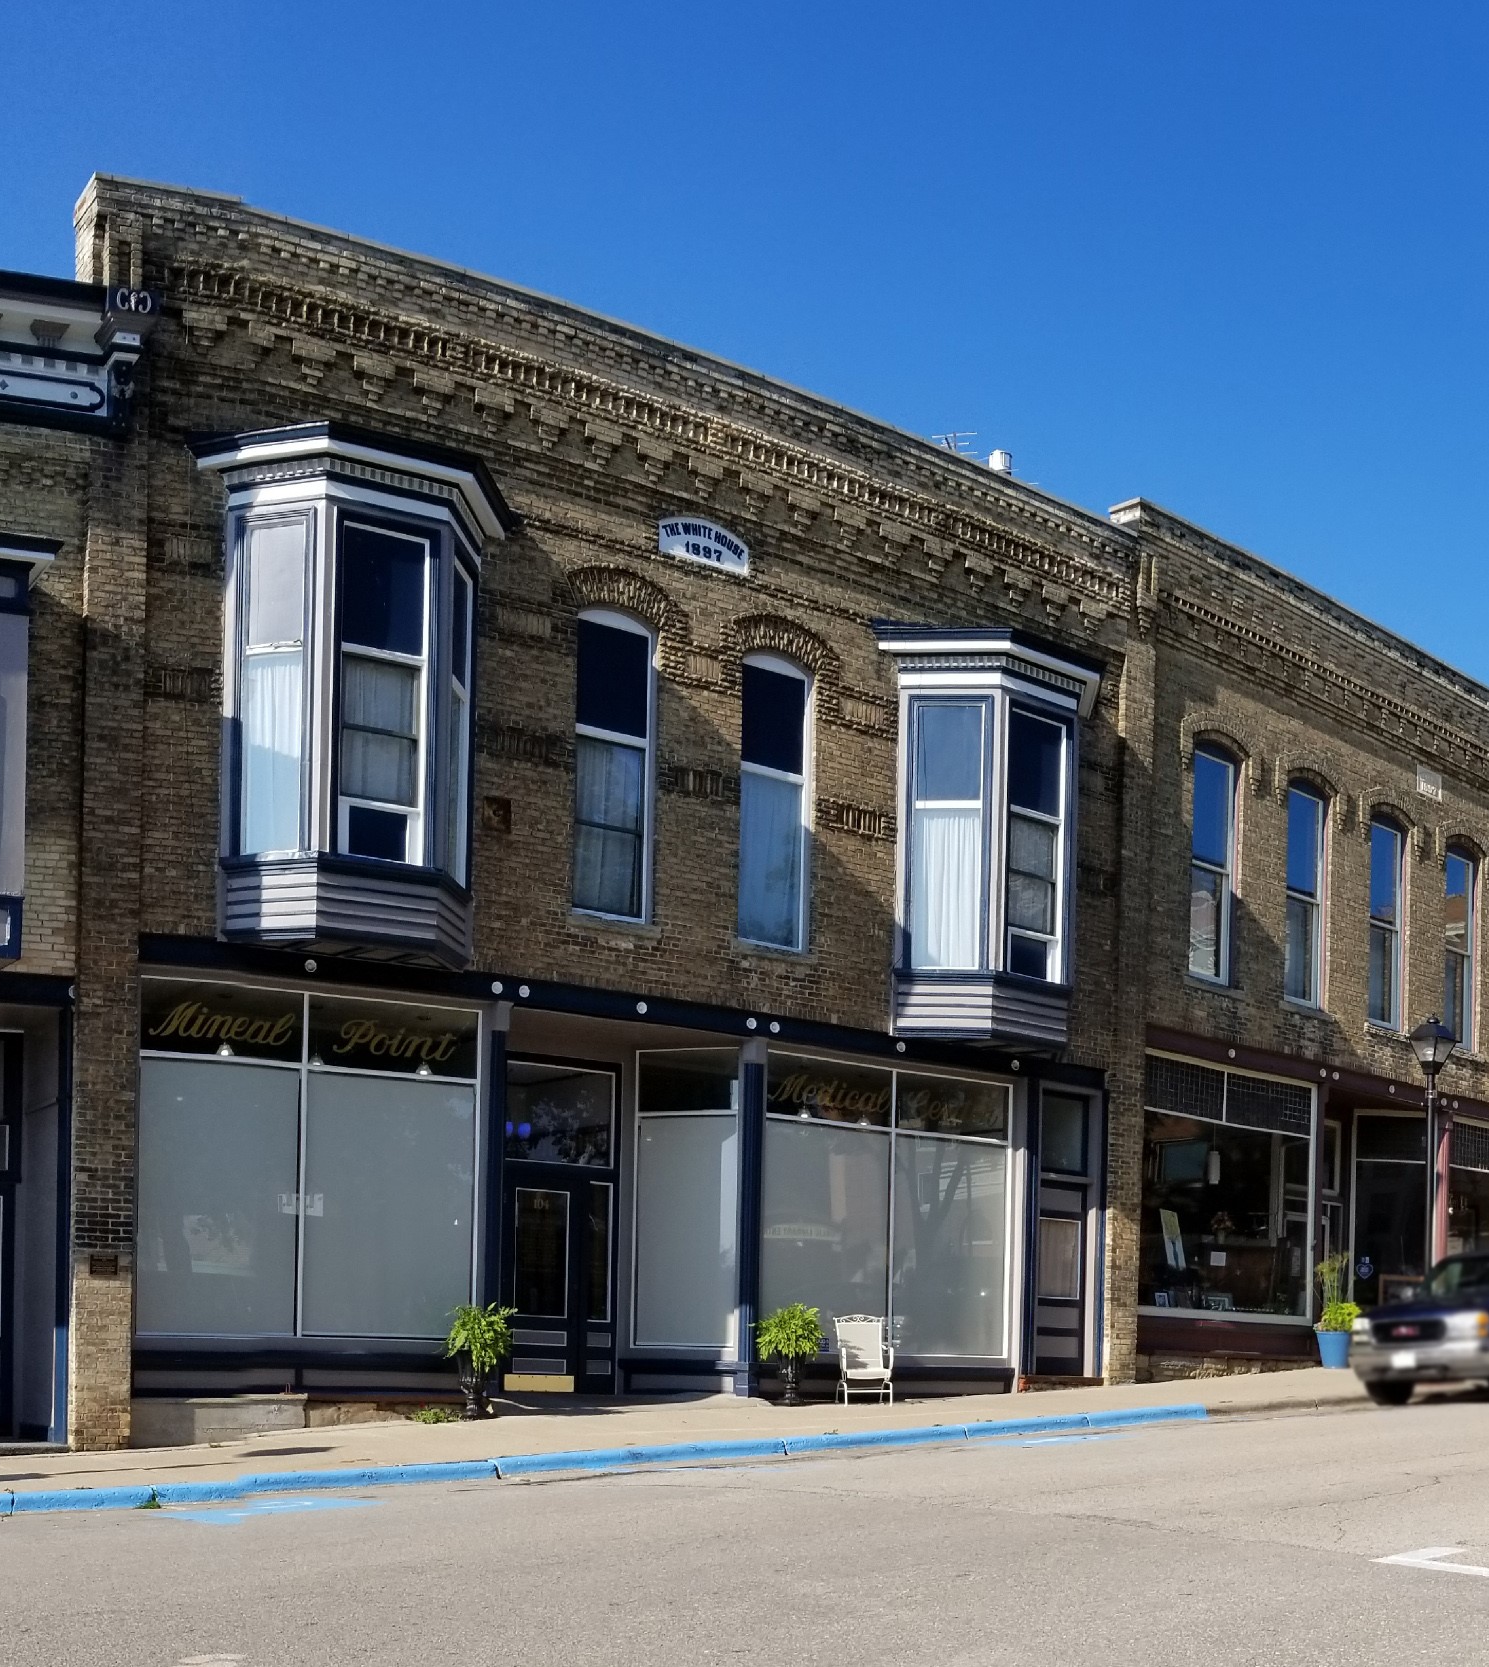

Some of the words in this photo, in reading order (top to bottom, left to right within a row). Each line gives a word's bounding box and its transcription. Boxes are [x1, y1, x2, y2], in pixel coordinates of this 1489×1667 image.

[662, 522, 681, 538] THE
[681, 522, 713, 540] WHITE
[714, 530, 745, 560] HOUSE
[332, 1018, 457, 1061] Point
[767, 1073, 891, 1114] Medical
[533, 1198, 550, 1210] 104
